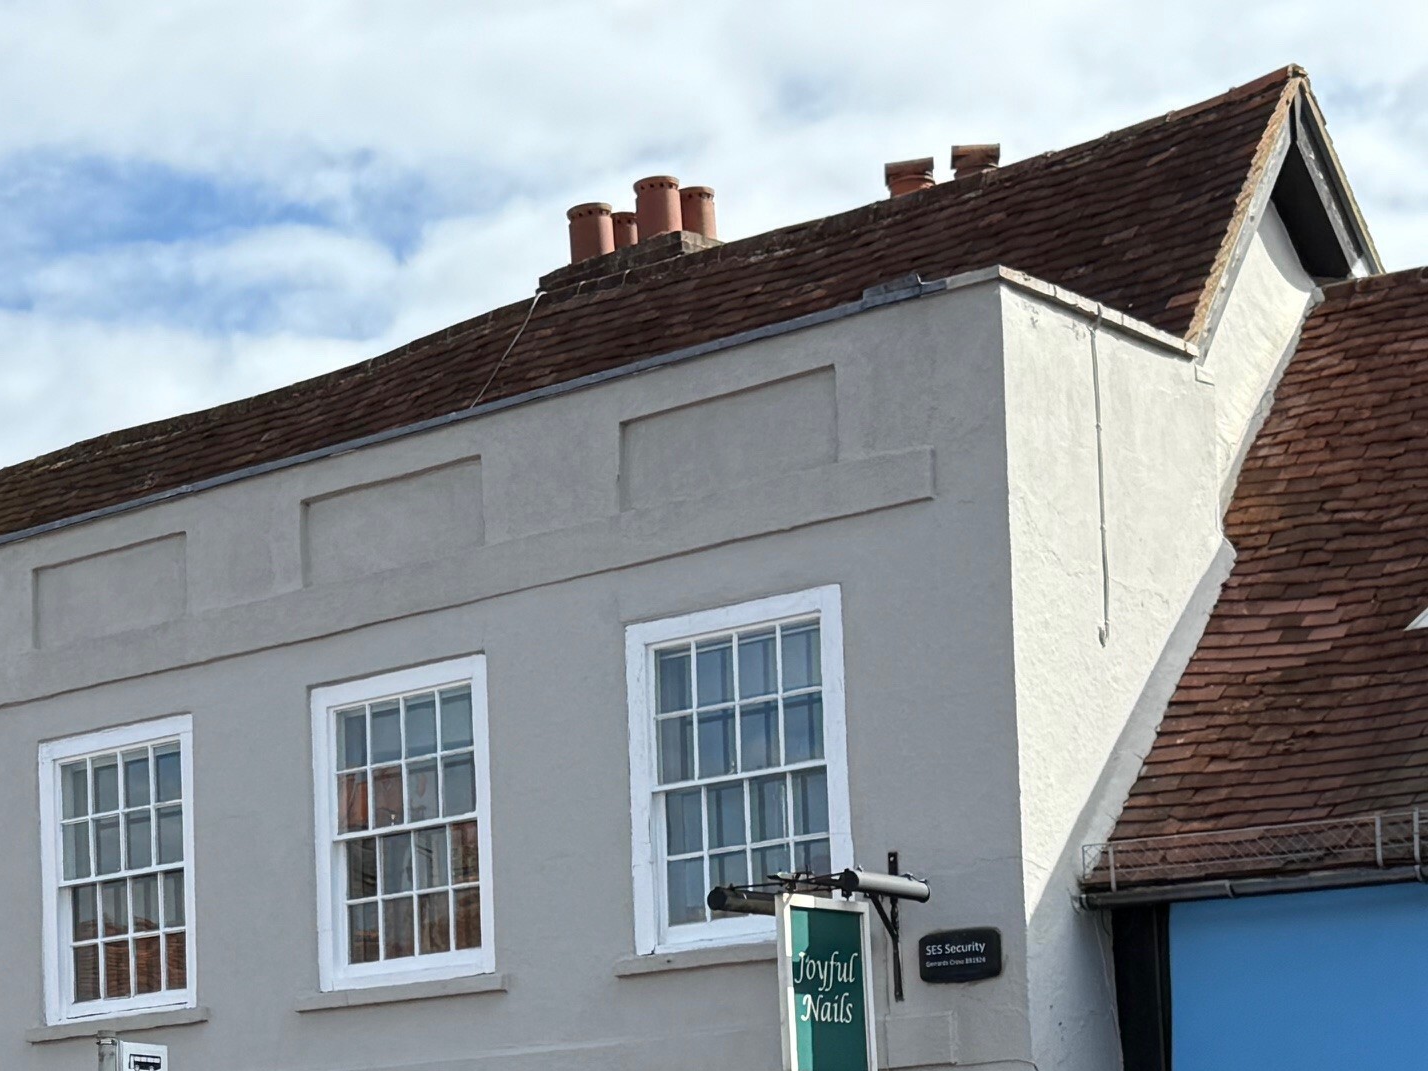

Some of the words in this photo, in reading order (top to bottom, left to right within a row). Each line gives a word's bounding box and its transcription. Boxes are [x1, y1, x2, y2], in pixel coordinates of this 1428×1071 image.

[925, 944, 943, 956] SES
[944, 941, 986, 953] Security
[794, 951, 858, 991] Joyful
[801, 993, 853, 1024] Nails
